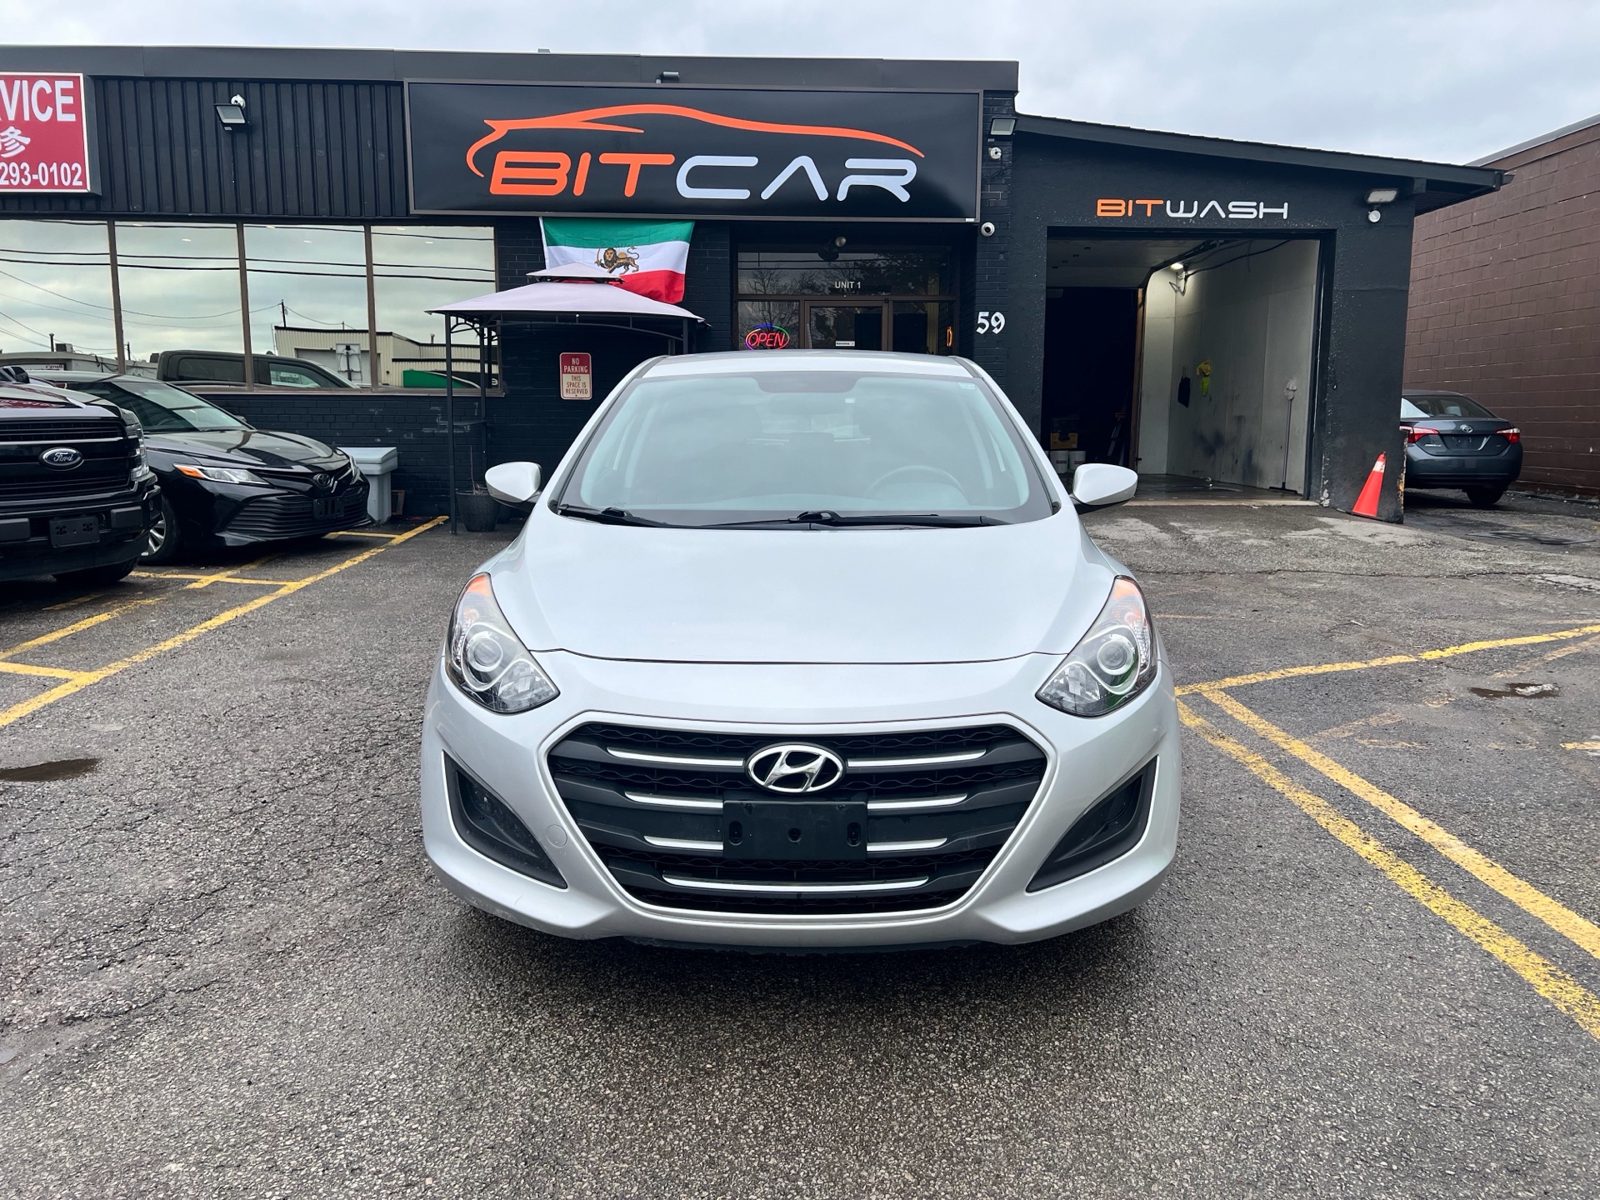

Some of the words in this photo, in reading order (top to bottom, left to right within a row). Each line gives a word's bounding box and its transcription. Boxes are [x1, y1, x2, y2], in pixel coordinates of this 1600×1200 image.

[0, 79, 76, 122] VICE
[0, 162, 83, 186] 293-0102
[489, 151, 917, 202] BITCAR
[1096, 198, 1289, 220] BITWASH
[834, 281, 855, 289] UNIT
[857, 281, 861, 289] 1
[976, 311, 1006, 334] 59
[748, 332, 786, 347] OPEN
[563, 365, 589, 373] PARKING
[571, 357, 580, 365] NO
[53, 452, 74, 462] Ford
